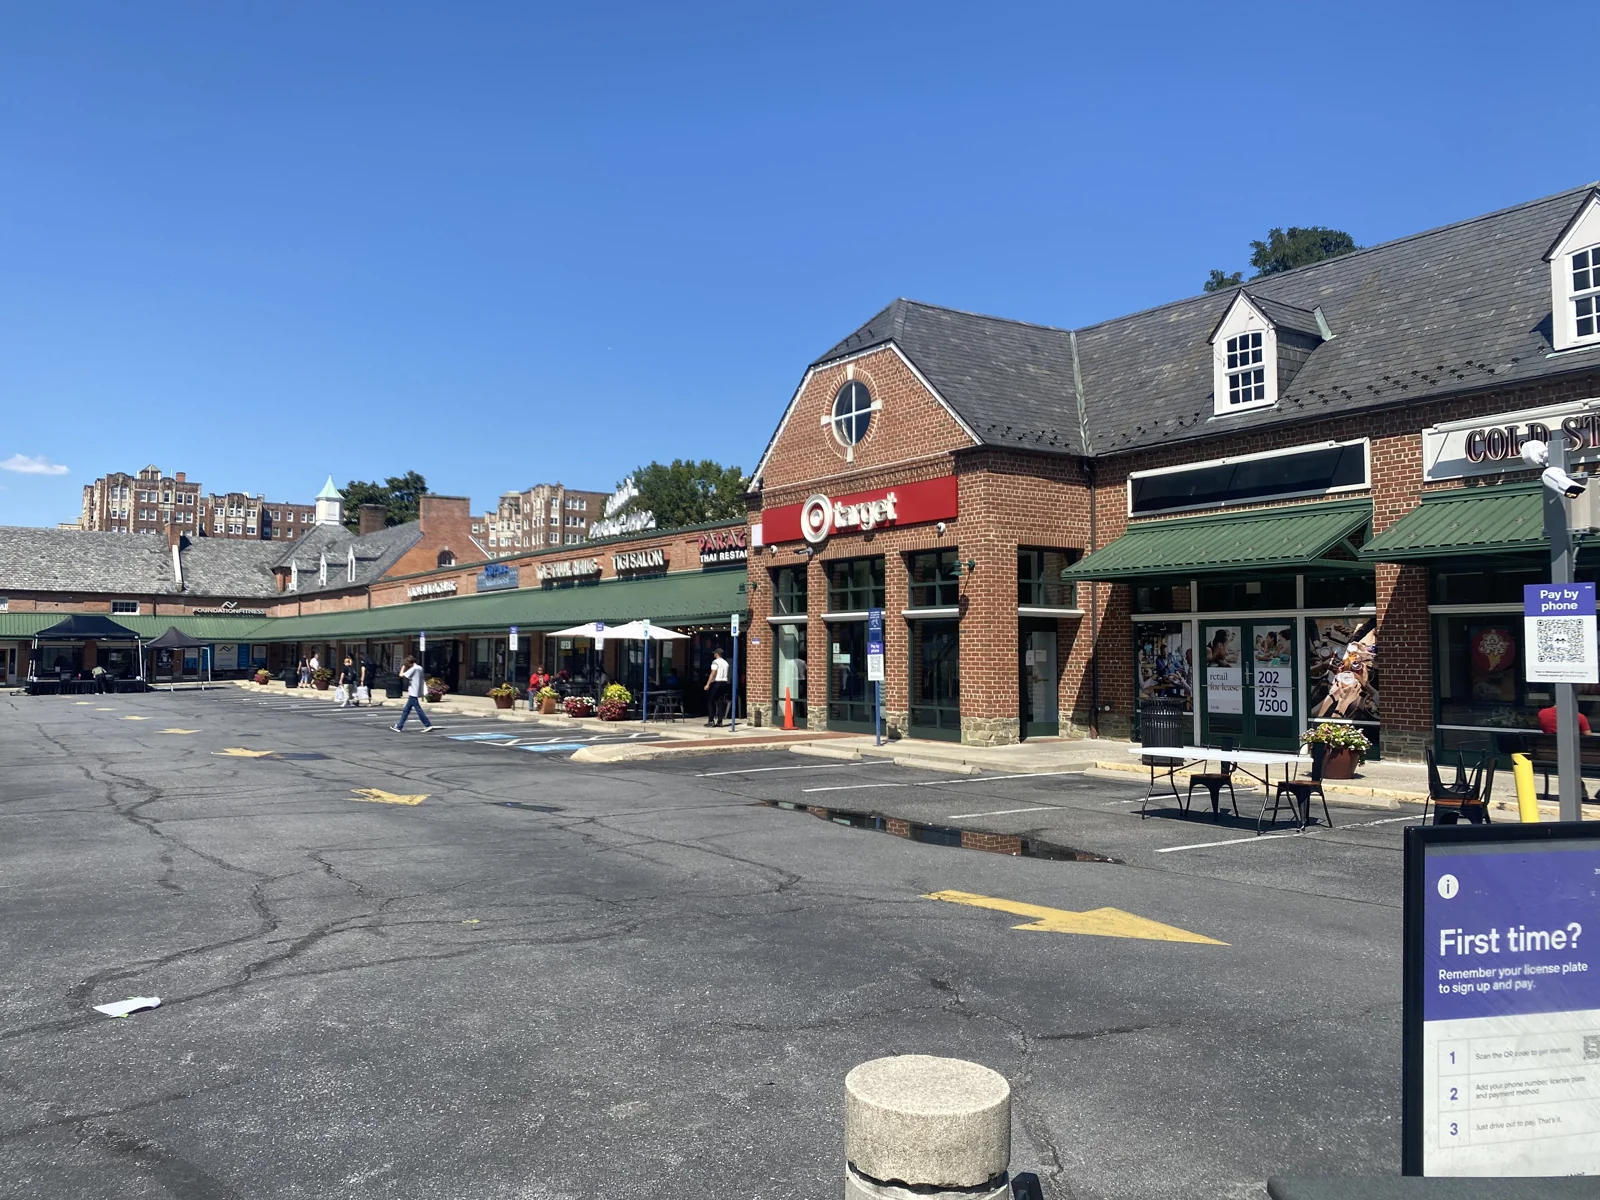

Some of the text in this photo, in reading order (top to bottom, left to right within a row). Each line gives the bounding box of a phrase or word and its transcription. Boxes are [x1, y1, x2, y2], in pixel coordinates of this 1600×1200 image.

[1465, 422, 1551, 463] COLD
[833, 492, 897, 530] target
[698, 530, 747, 552] PARAG
[630, 549, 664, 568] SALON
[700, 554, 716, 562] THAI
[1540, 589, 1579, 600] Pay by
[1542, 602, 1578, 612] phone
[1210, 672, 1228, 680] retail
[1258, 671, 1279, 684] 202
[1222, 683, 1239, 691] lease
[1259, 685, 1277, 698] 375
[1258, 700, 1288, 712] 7500
[1440, 922, 1582, 956] First time?
[1439, 962, 1588, 980] Remember your license plate
[1439, 979, 1536, 995] to sign up and pay.
[1450, 1051, 1455, 1064] 1
[1450, 1088, 1458, 1100] 2
[1489, 1091, 1514, 1099] payment
[1450, 1123, 1458, 1136] 3
